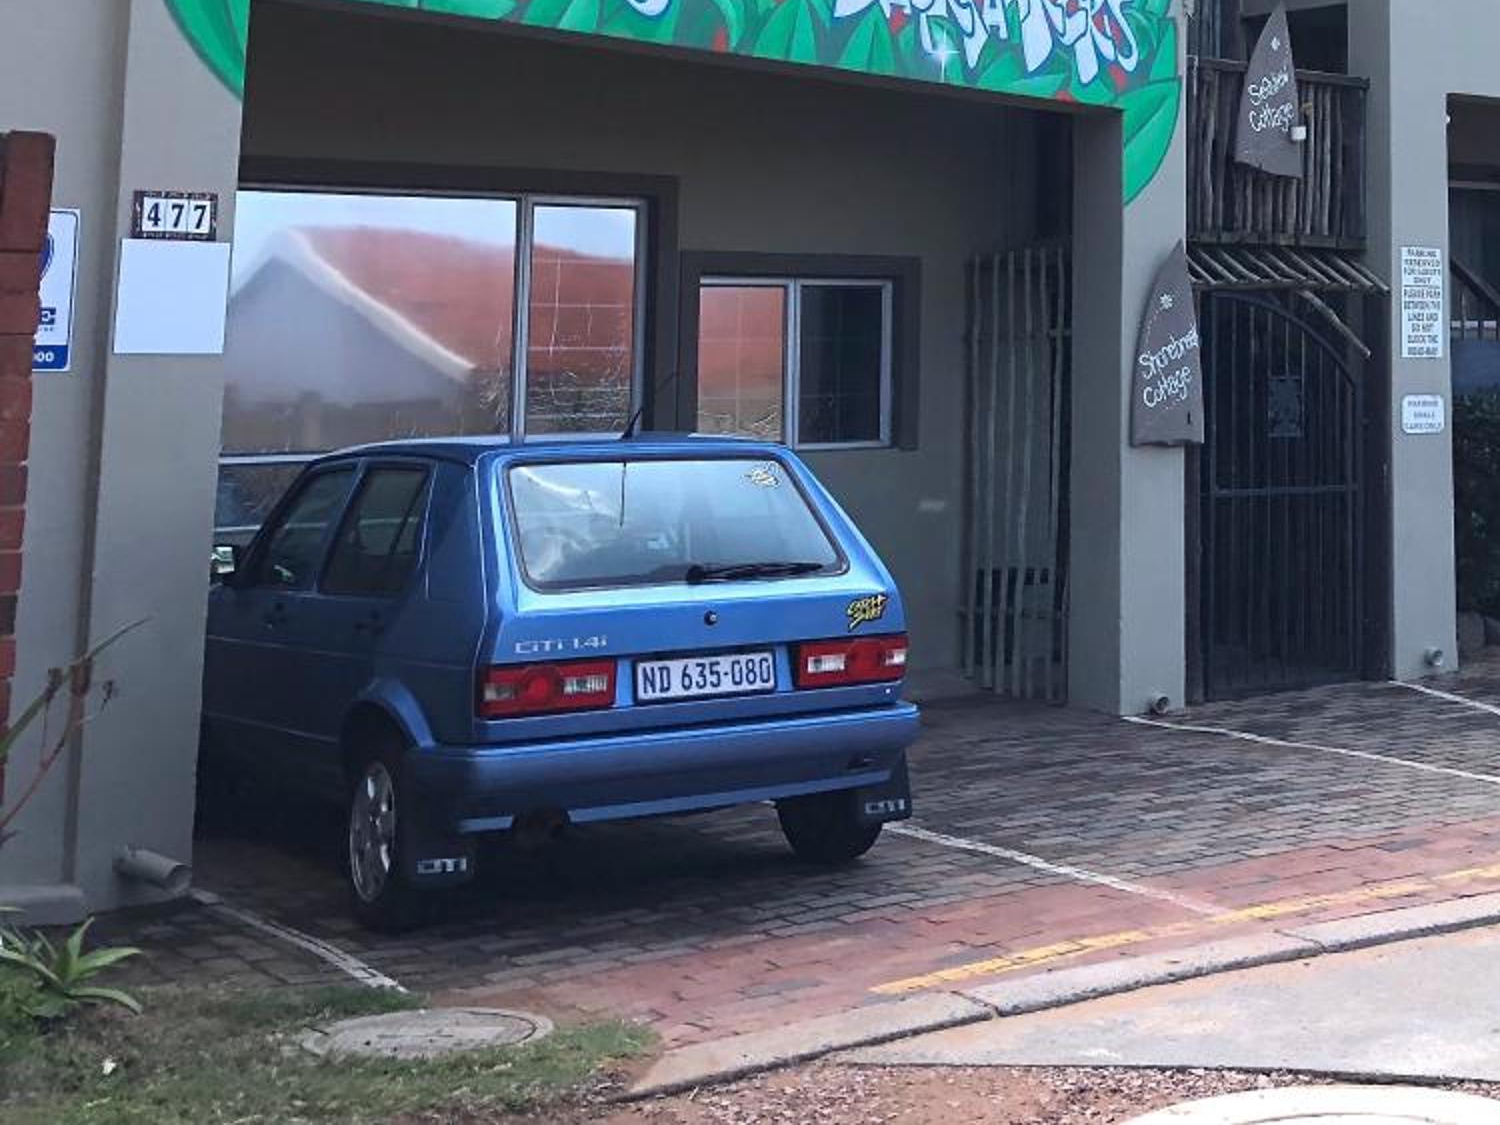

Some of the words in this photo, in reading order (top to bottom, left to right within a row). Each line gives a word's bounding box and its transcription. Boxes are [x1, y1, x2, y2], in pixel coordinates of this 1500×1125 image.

[147, 202, 207, 230] 477
[1143, 366, 1192, 407] Cottage
[642, 666, 671, 694] ND
[681, 657, 771, 691] 635-080
